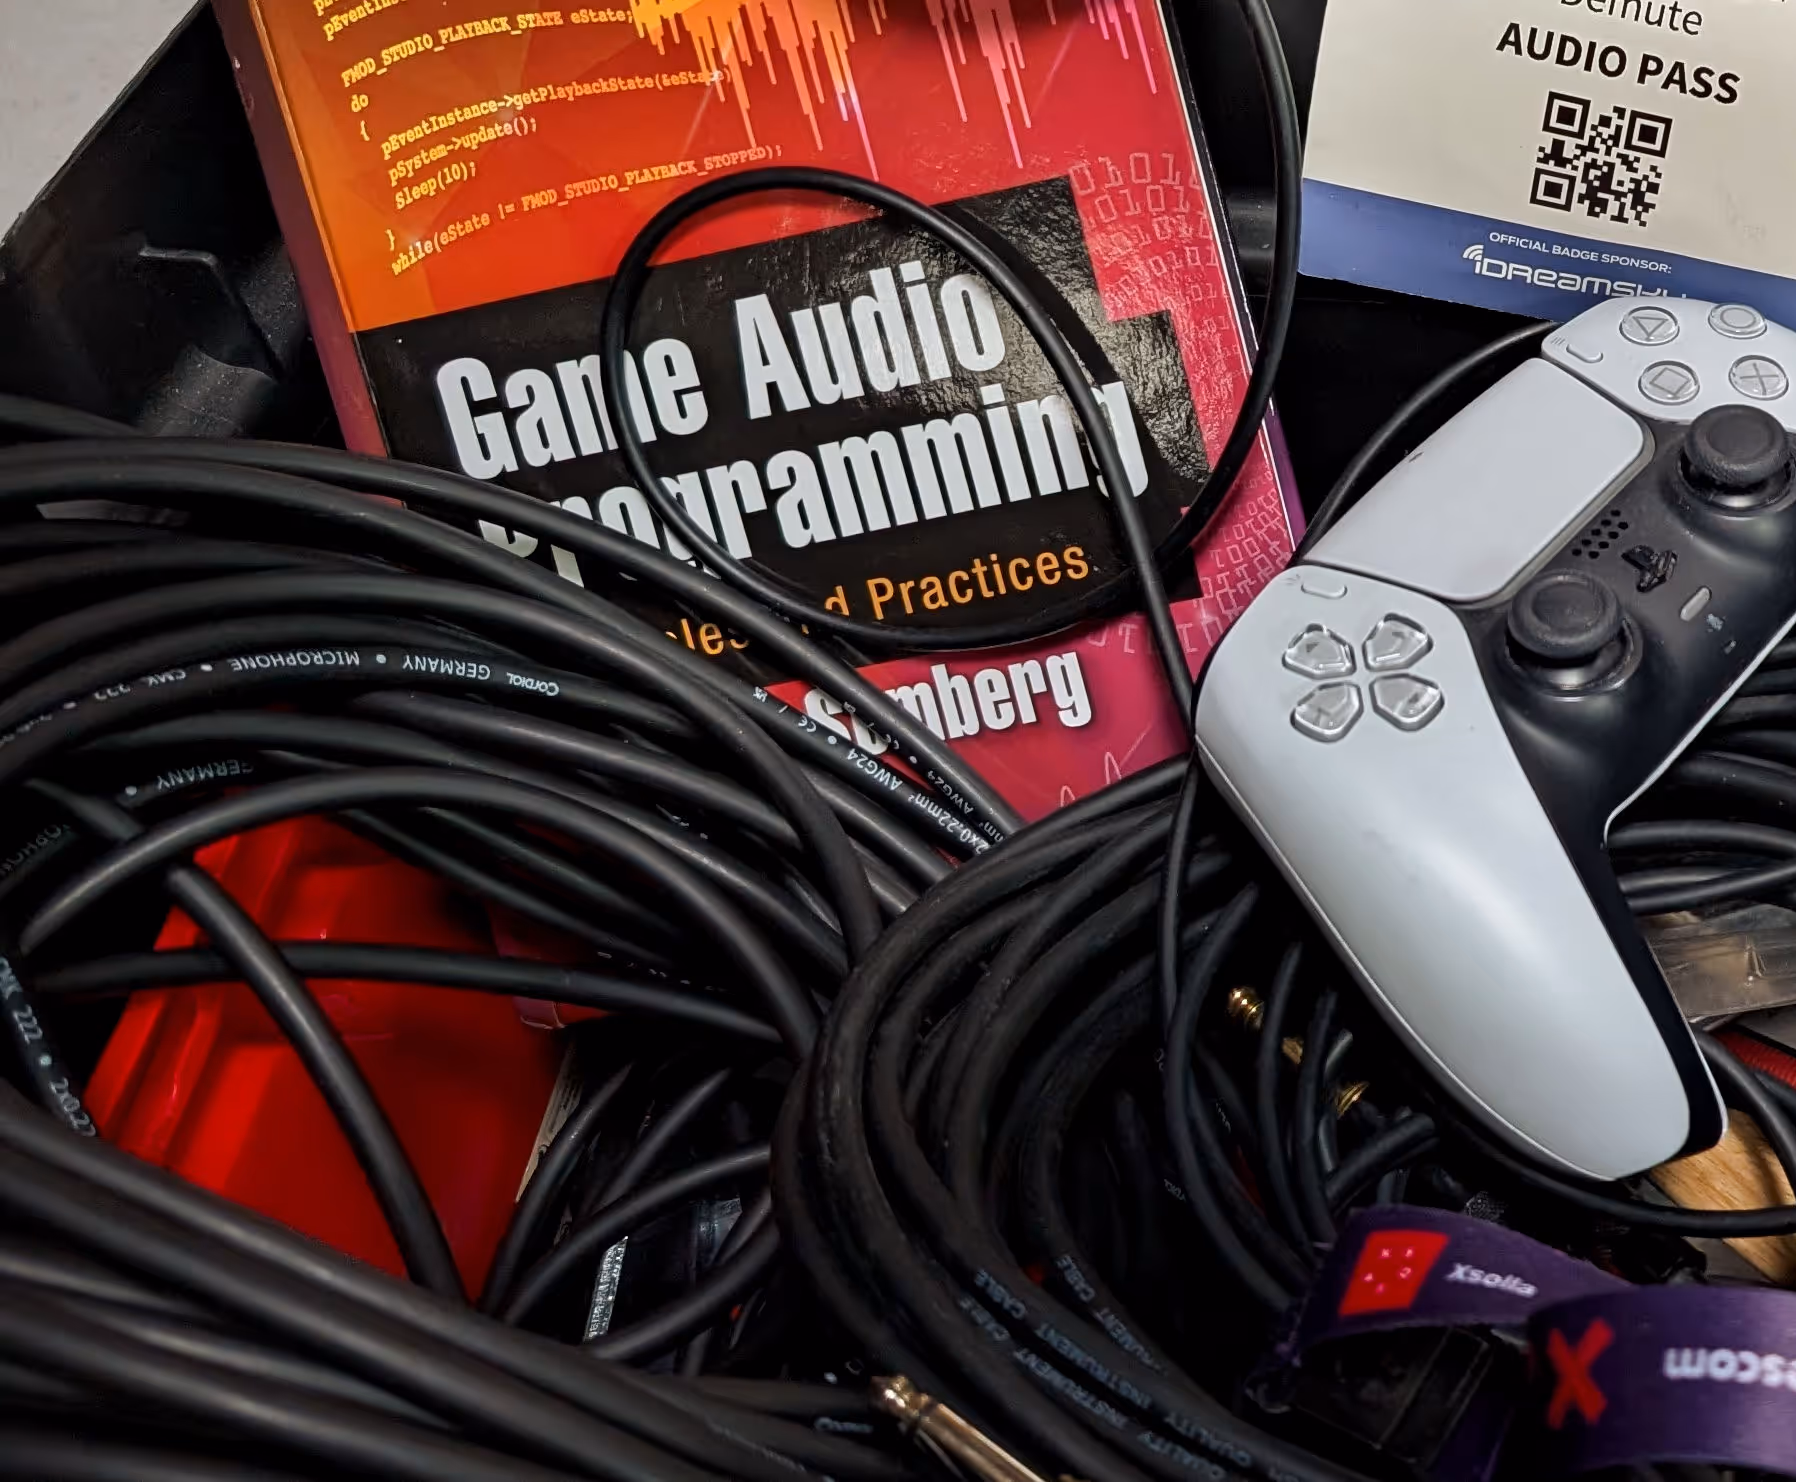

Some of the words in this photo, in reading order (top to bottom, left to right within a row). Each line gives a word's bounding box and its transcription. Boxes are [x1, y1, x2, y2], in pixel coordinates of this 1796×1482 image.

[341, 12, 563, 88] FMOD_STUDIO_PLAYBACK_STATE
[571, 7, 634, 25] eState;
[1495, 22, 1627, 78] AUDIO
[1636, 53, 1741, 105] PASS
[350, 94, 370, 113] do
[387, 117, 537, 187] pSystem->update();
[394, 161, 477, 210] Sleep(10);
[391, 211, 490, 275] while(eState
[520, 143, 784, 213] FMOD_STUDIO_PLAYBACK_STOPPED);
[1489, 231, 1550, 254] OFFICIAL
[1551, 244, 1599, 263] BADGE
[1601, 253, 1673, 275] SPONSOR:
[434, 334, 704, 482] Game
[733, 258, 1009, 421] Audio
[478, 379, 1151, 588] ogramming
[866, 543, 1090, 622] Practices
[230, 649, 360, 673] MICROPHONE
[402, 654, 492, 683] GERMANY
[846, 747, 904, 792] AWG24
